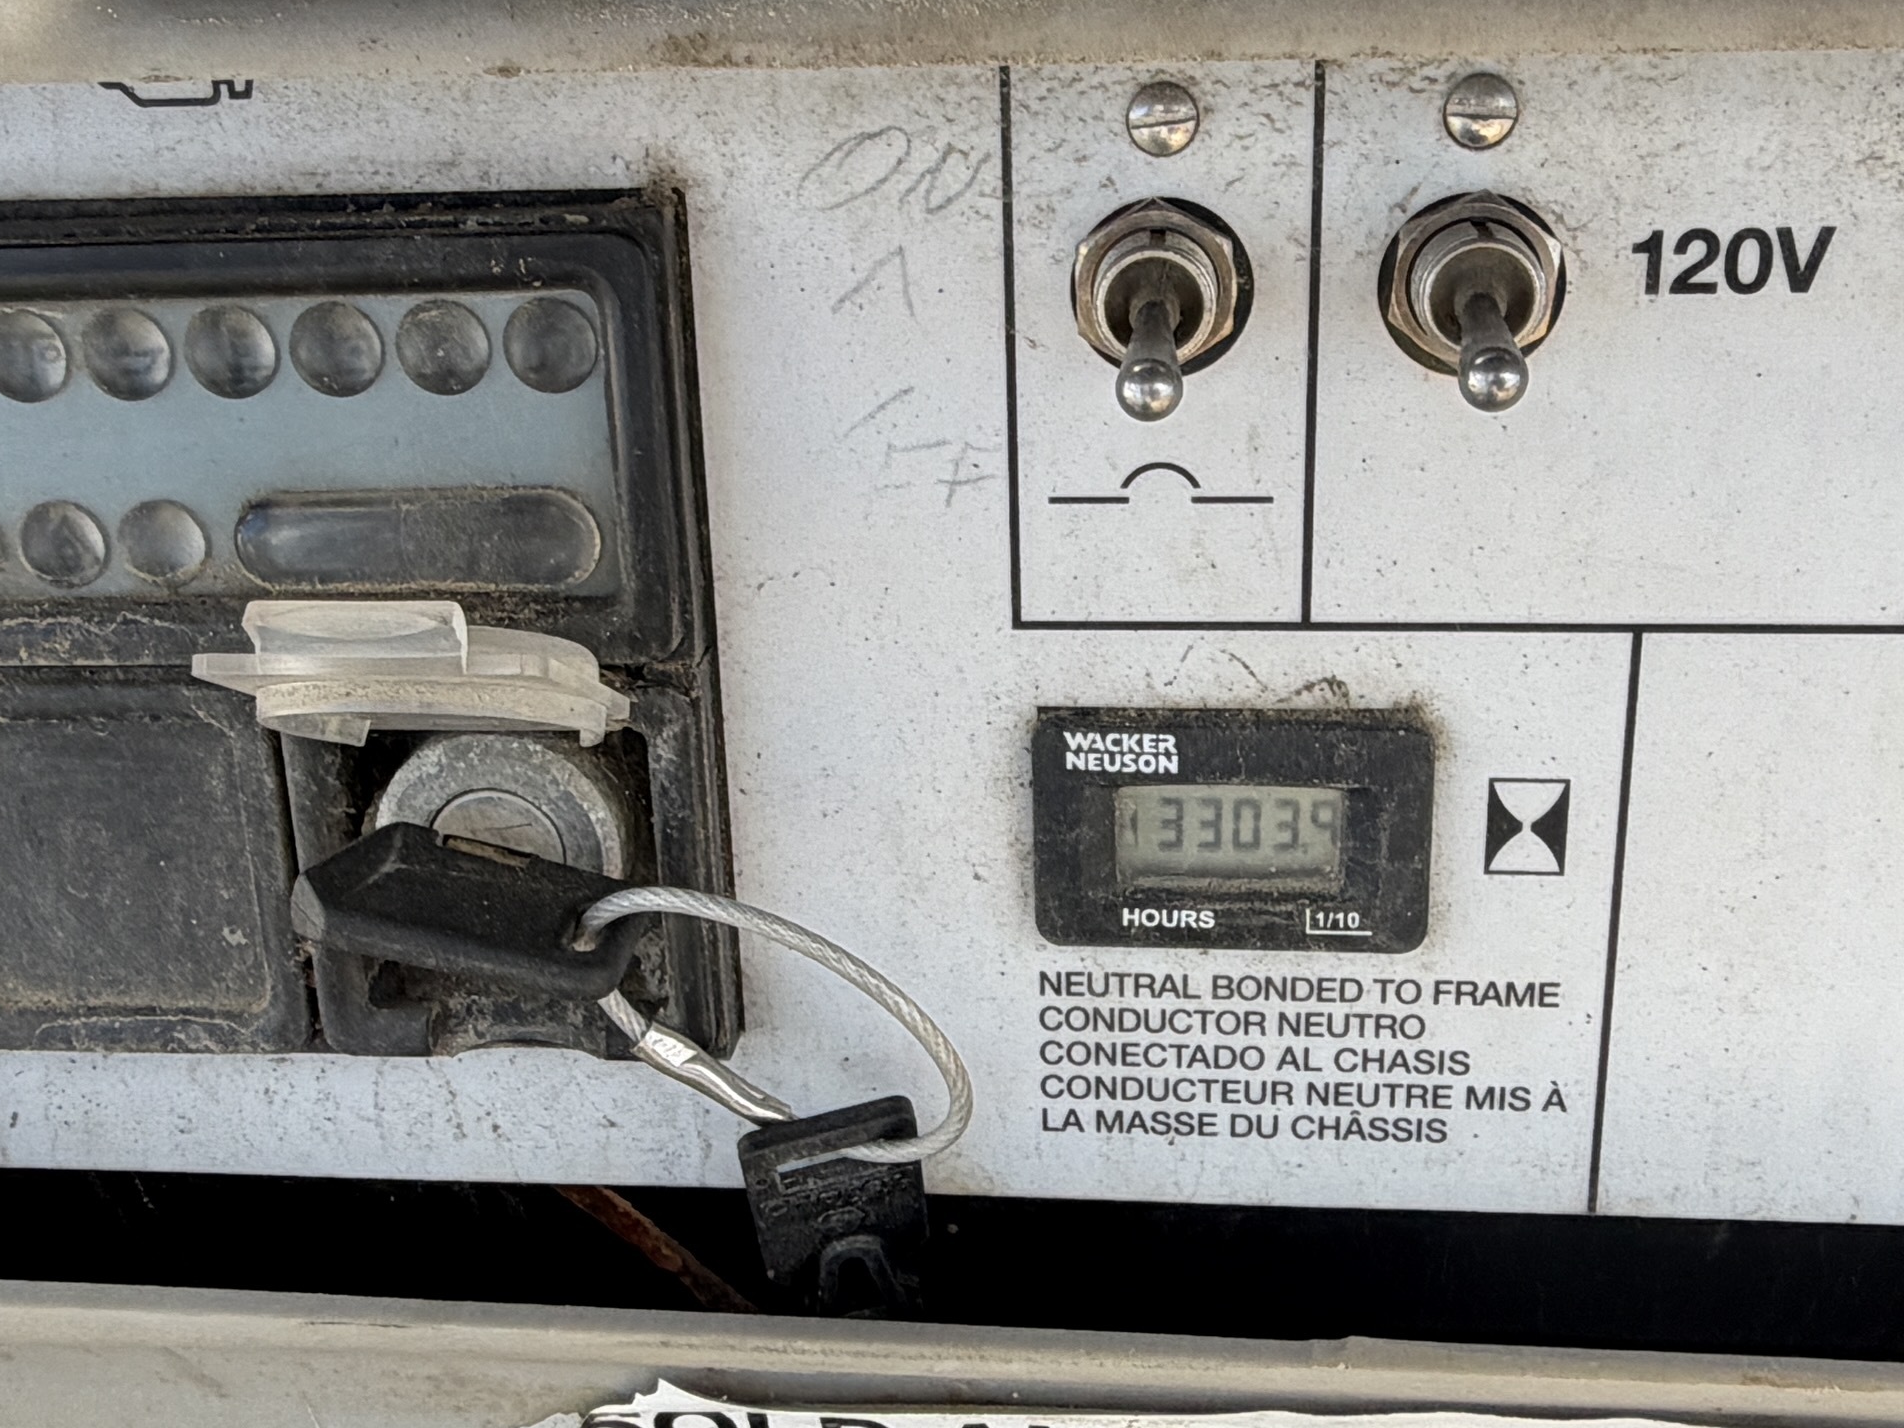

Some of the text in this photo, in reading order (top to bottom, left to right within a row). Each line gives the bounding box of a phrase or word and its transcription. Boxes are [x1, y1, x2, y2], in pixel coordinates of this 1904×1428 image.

[1630, 225, 1838, 297] 120V
[1062, 730, 1178, 754] WACKER
[1064, 752, 1179, 774] NEUSON
[1122, 907, 1216, 929] HOURS
[1314, 911, 1361, 929] 1/10
[1038, 970, 1562, 1008] NEUTRAL BONDED TO FRAME
[1038, 1005, 1427, 1040] CONDUCTOR NEUTRO
[1039, 1039, 1471, 1076] CONECTADO AL CHASIS
[1040, 1074, 1568, 1113] CONDUCTEUR NEUTRE MIS À
[1041, 1107, 1448, 1144] LA MASSE DU CHÂSSIS
